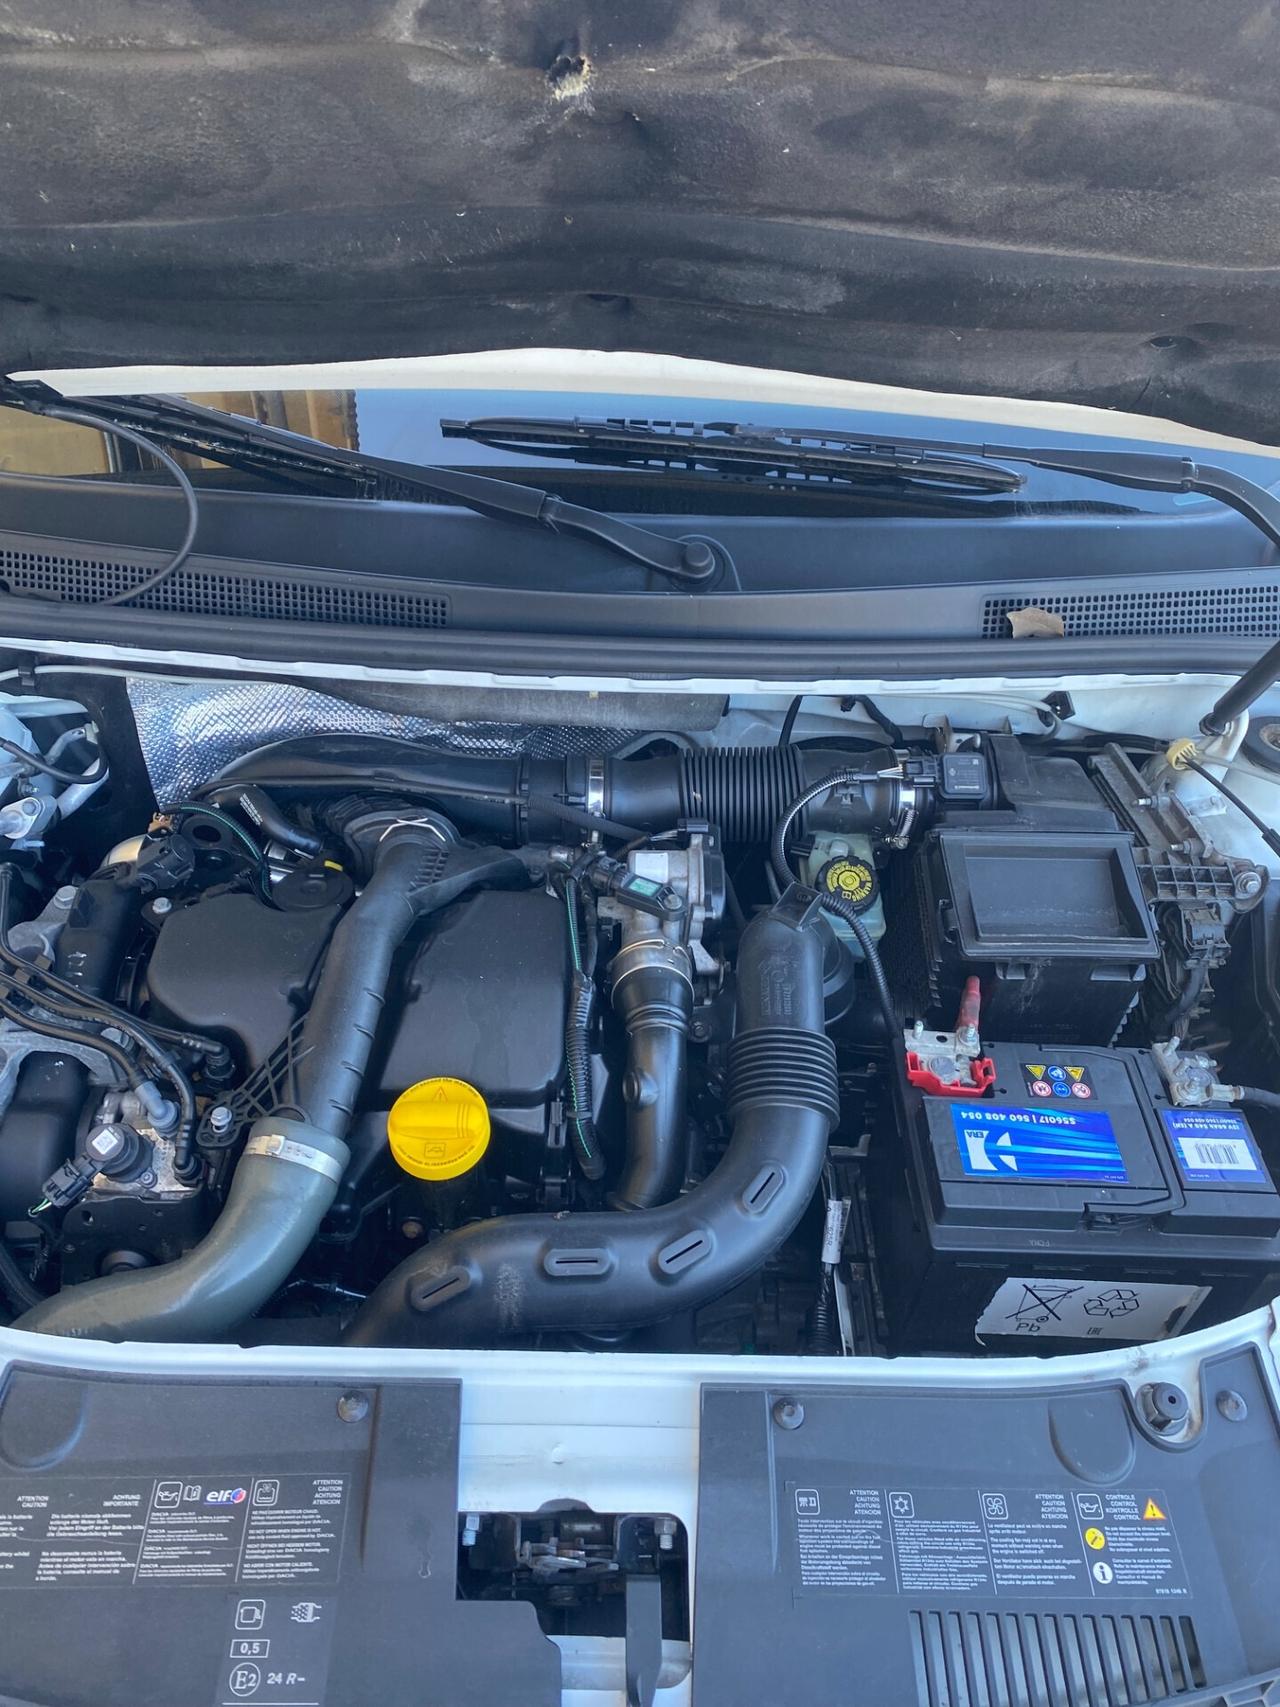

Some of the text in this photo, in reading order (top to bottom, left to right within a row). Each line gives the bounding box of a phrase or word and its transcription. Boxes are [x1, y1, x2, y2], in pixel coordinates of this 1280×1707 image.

[961, 1111, 982, 1120] 054
[986, 1113, 1006, 1121] 408
[1010, 1114, 1030, 1123] 560
[1016, 1322, 1041, 1332] Pb
[206, 1489, 231, 1502] elf
[240, 1643, 260, 1655] 0,5
[267, 1672, 282, 1684] 24
